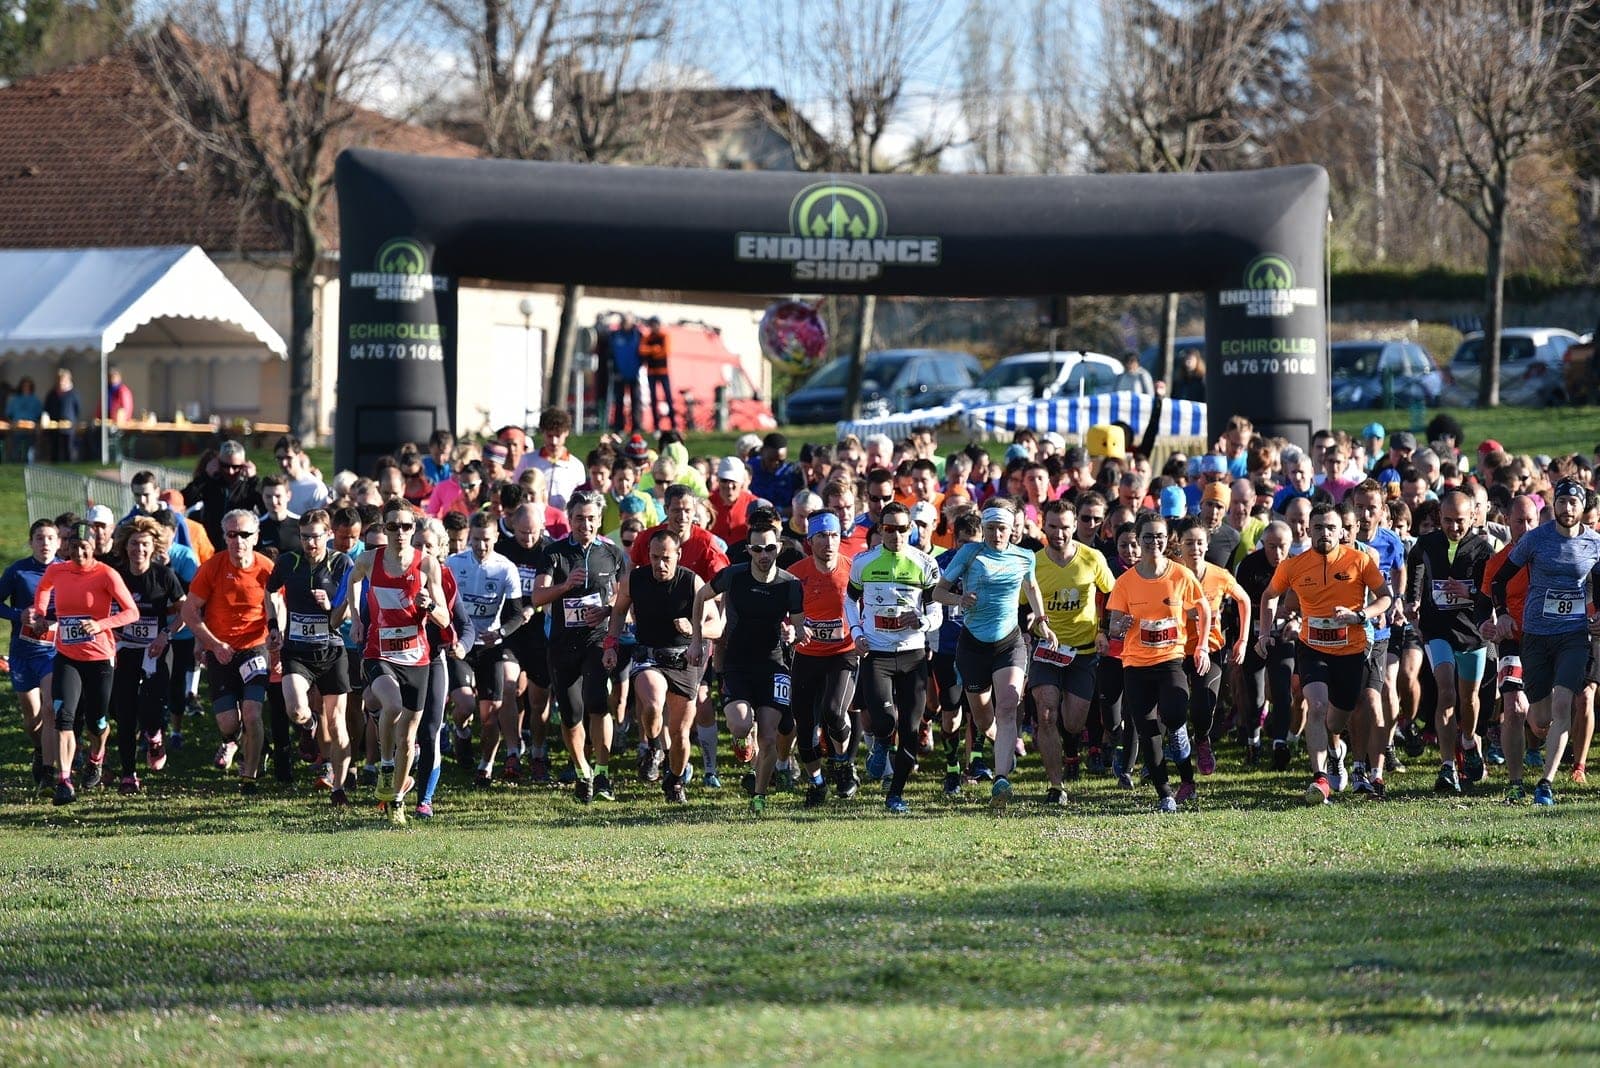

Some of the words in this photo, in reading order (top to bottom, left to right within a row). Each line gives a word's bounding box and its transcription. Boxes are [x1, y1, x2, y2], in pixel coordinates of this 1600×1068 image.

[738, 236, 939, 262] ENDURANCE
[796, 260, 880, 280] SHOP
[350, 272, 449, 291] ENDURANCE
[376, 286, 424, 301] SHOP
[1219, 288, 1317, 306] ENDURANCE
[1246, 302, 1294, 317] SHOP
[350, 344, 365, 359] 04
[367, 344, 384, 359] 76
[388, 344, 406, 359] 70
[410, 344, 427, 359] 10
[1221, 338, 1316, 355] ECHIROLLES
[1223, 359, 1238, 375] 04
[1241, 359, 1258, 374] 76
[1262, 359, 1279, 373] 70
[1282, 358, 1299, 374] 10
[473, 604, 487, 615] 79
[1047, 600, 1080, 611] Ut4M
[1557, 600, 1573, 614] 89
[131, 624, 149, 637] 163
[302, 624, 316, 635] 84
[813, 628, 834, 640] 167
[776, 684, 788, 698] 10
